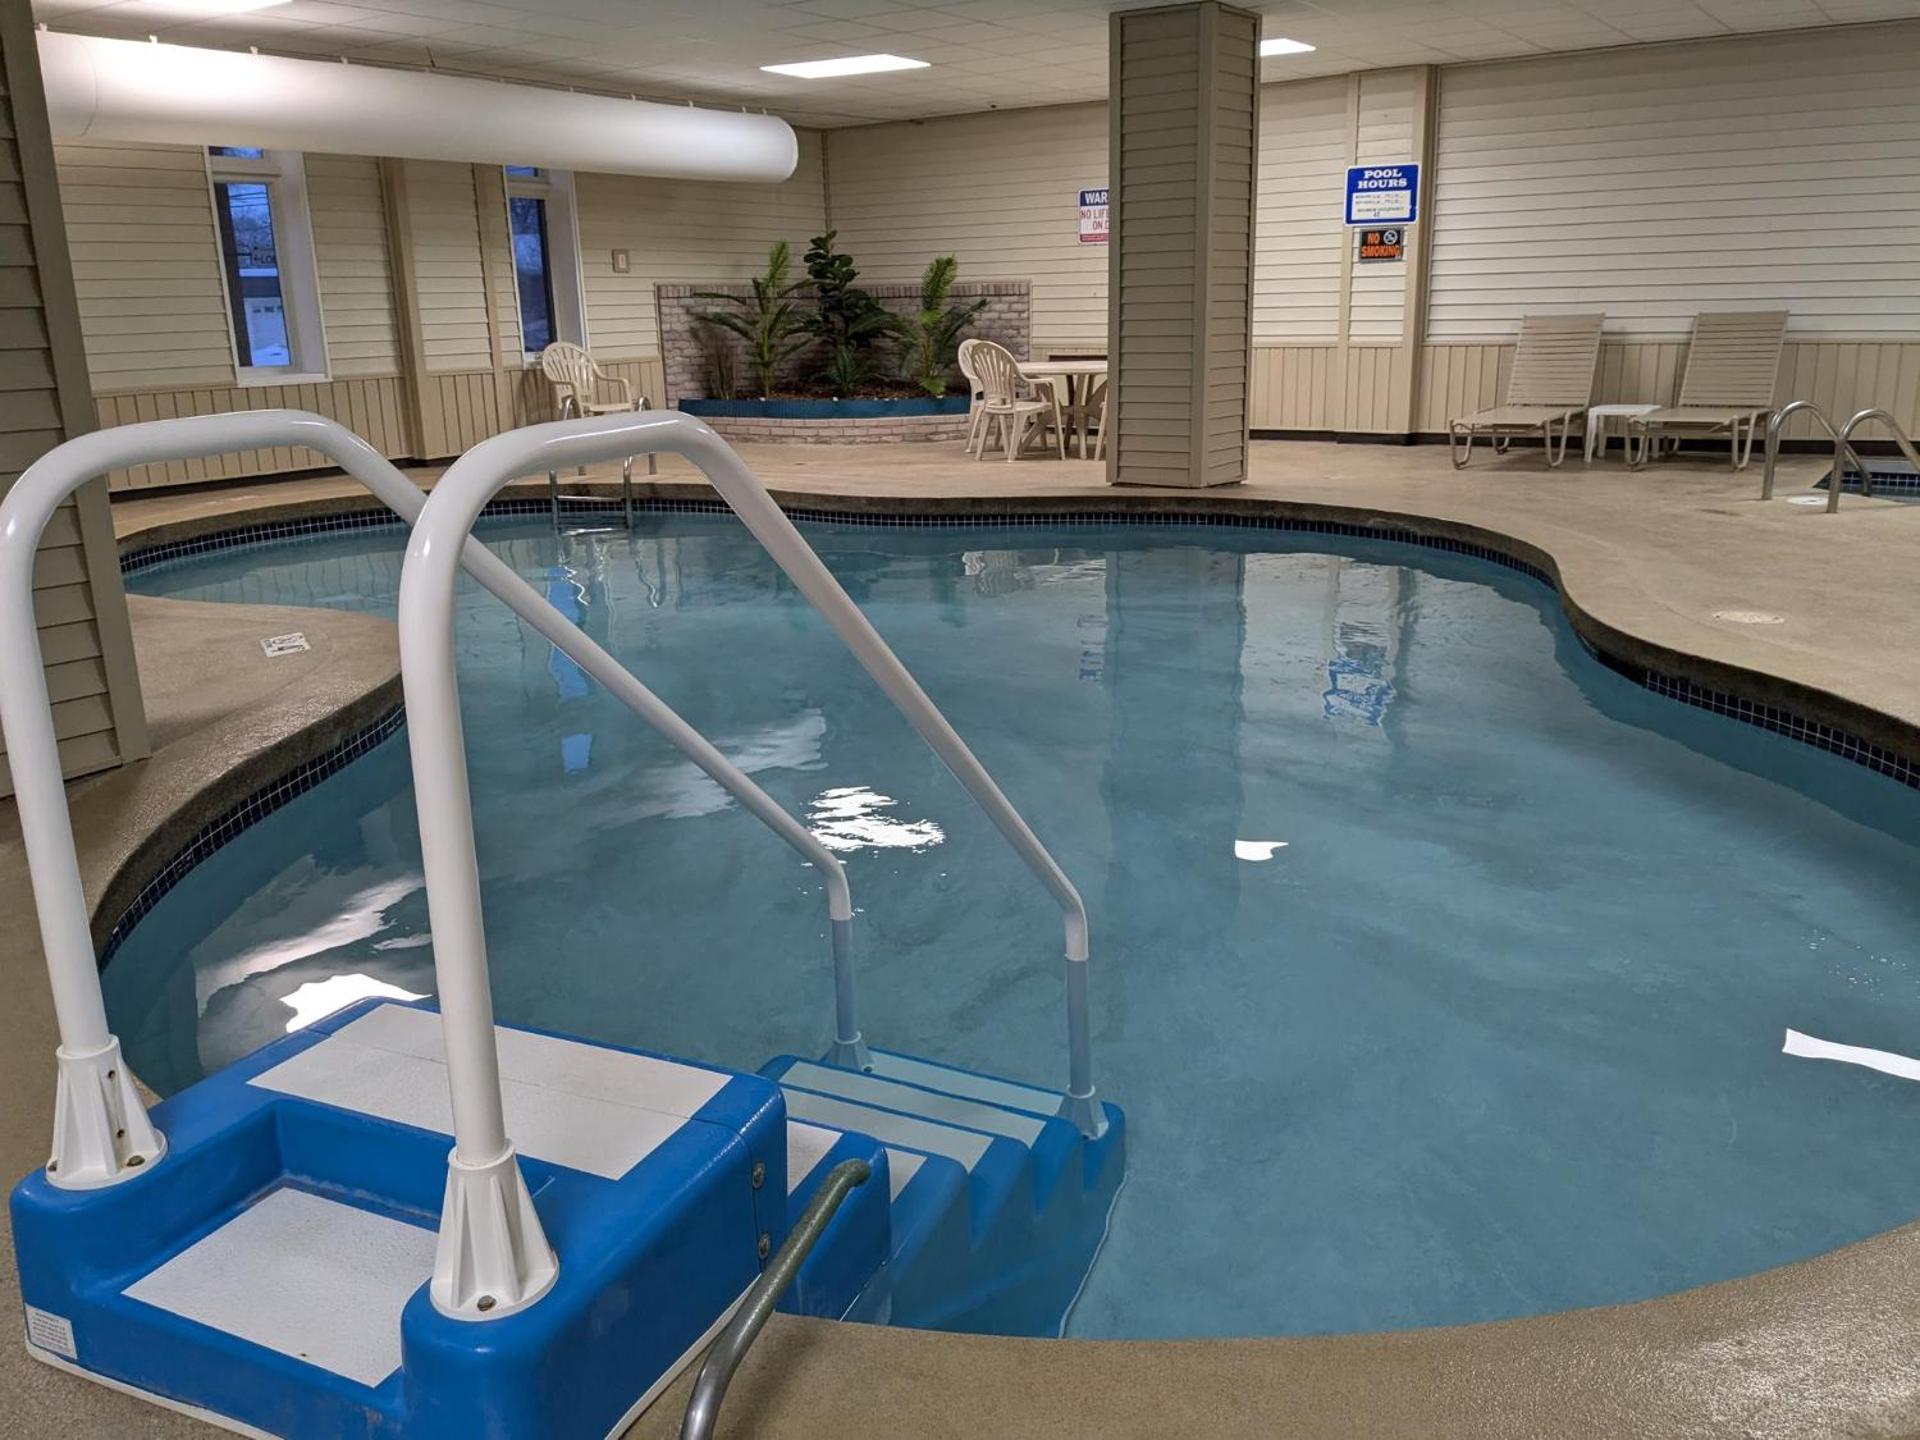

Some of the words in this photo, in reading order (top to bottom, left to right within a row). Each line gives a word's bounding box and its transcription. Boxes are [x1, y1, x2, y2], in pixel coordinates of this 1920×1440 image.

[1363, 168, 1402, 179] POOL
[1357, 178, 1408, 189] HOURS
[1080, 208, 1091, 219] NO
[1092, 220, 1103, 230] ON
[1367, 232, 1380, 244] NO
[1361, 245, 1401, 257] SMOKING
